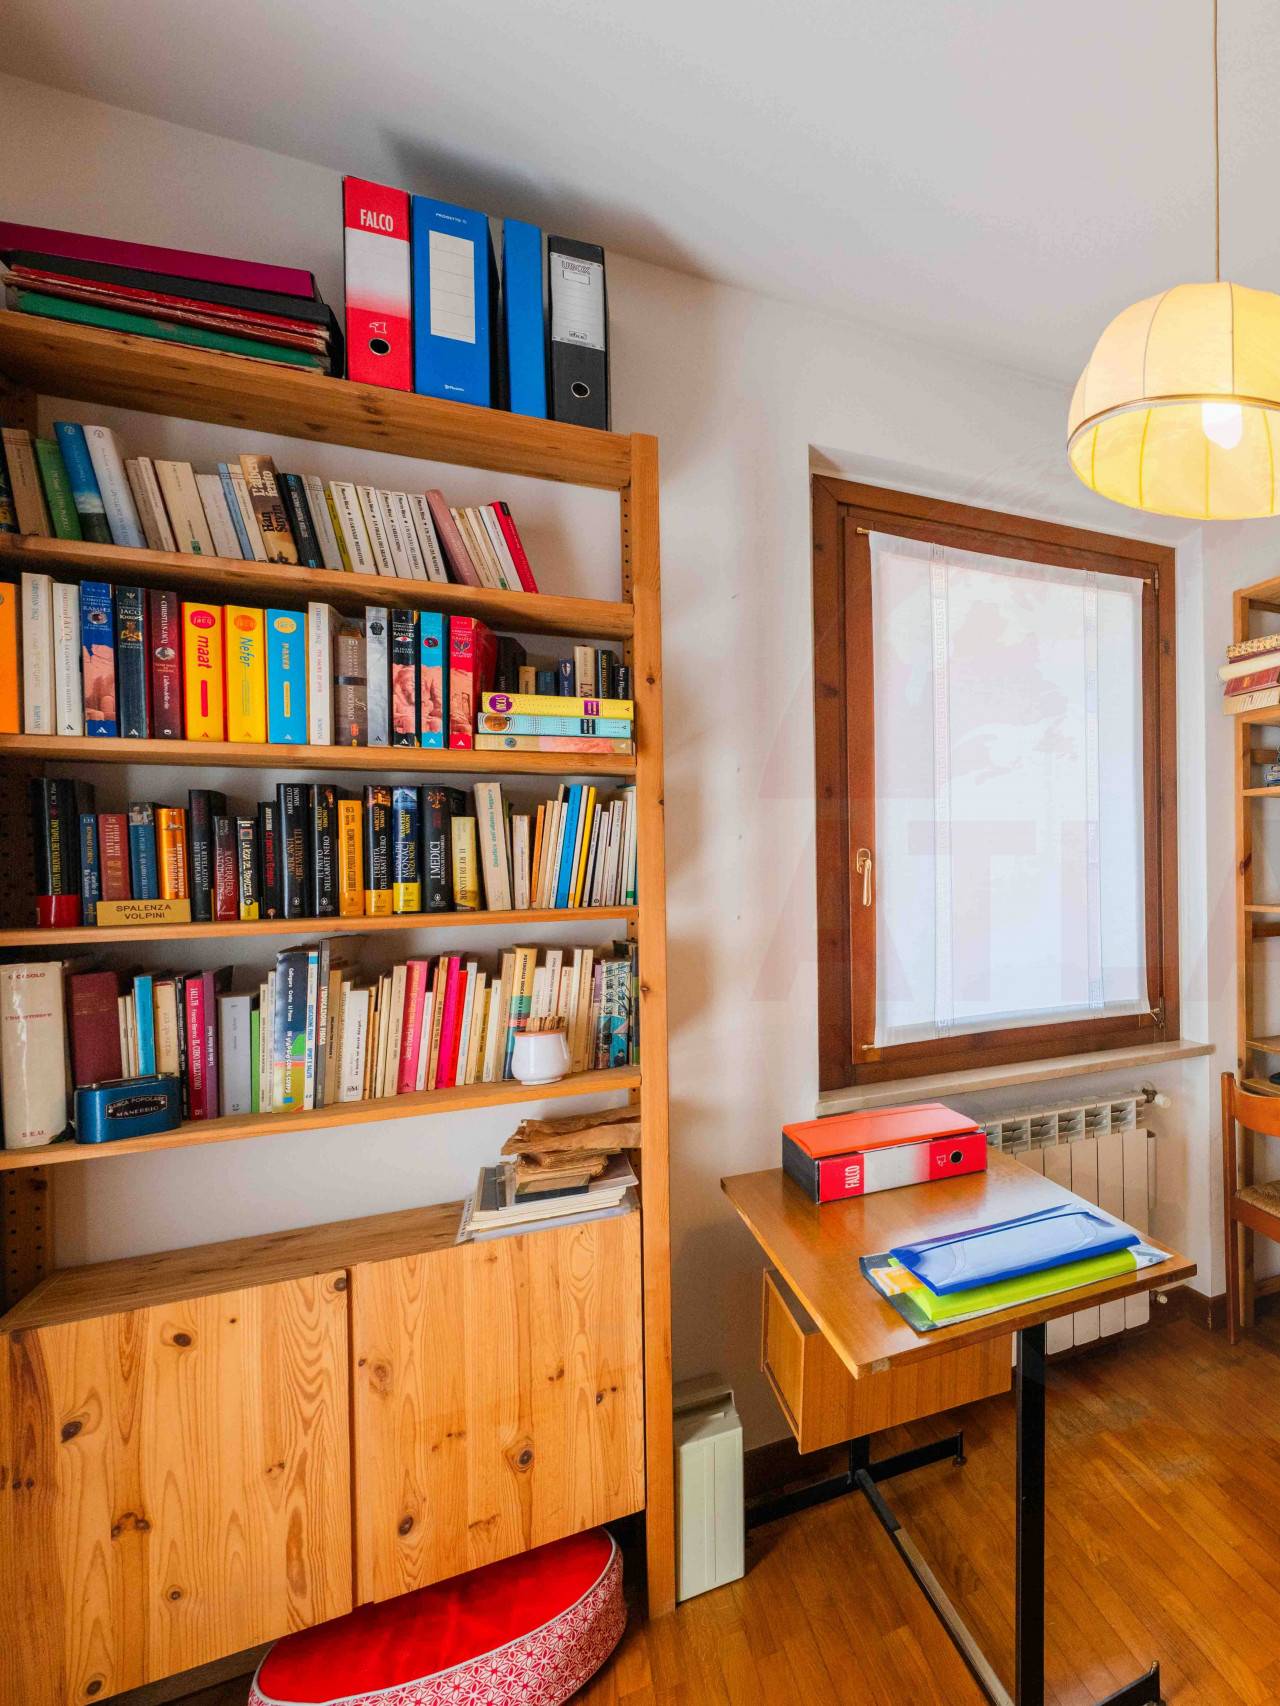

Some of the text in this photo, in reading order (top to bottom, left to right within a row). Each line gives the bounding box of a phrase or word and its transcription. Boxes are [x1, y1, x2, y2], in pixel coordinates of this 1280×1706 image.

[360, 209, 394, 232] FALCO
[259, 510, 275, 533] Han
[196, 635, 212, 669] maat
[239, 636, 256, 667] Nefer
[285, 786, 294, 814] MARCELLO
[292, 785, 300, 806] SIMONI
[322, 834, 331, 855] NERO
[378, 834, 387, 854] NERO
[429, 840, 440, 874] MEDICI
[458, 875, 467, 901] LUXOR
[116, 904, 172, 912] SPALENZA
[124, 911, 166, 920] VOLPINI
[317, 1027, 326, 1046] FISICA
[845, 1165, 860, 1189] FALCO
